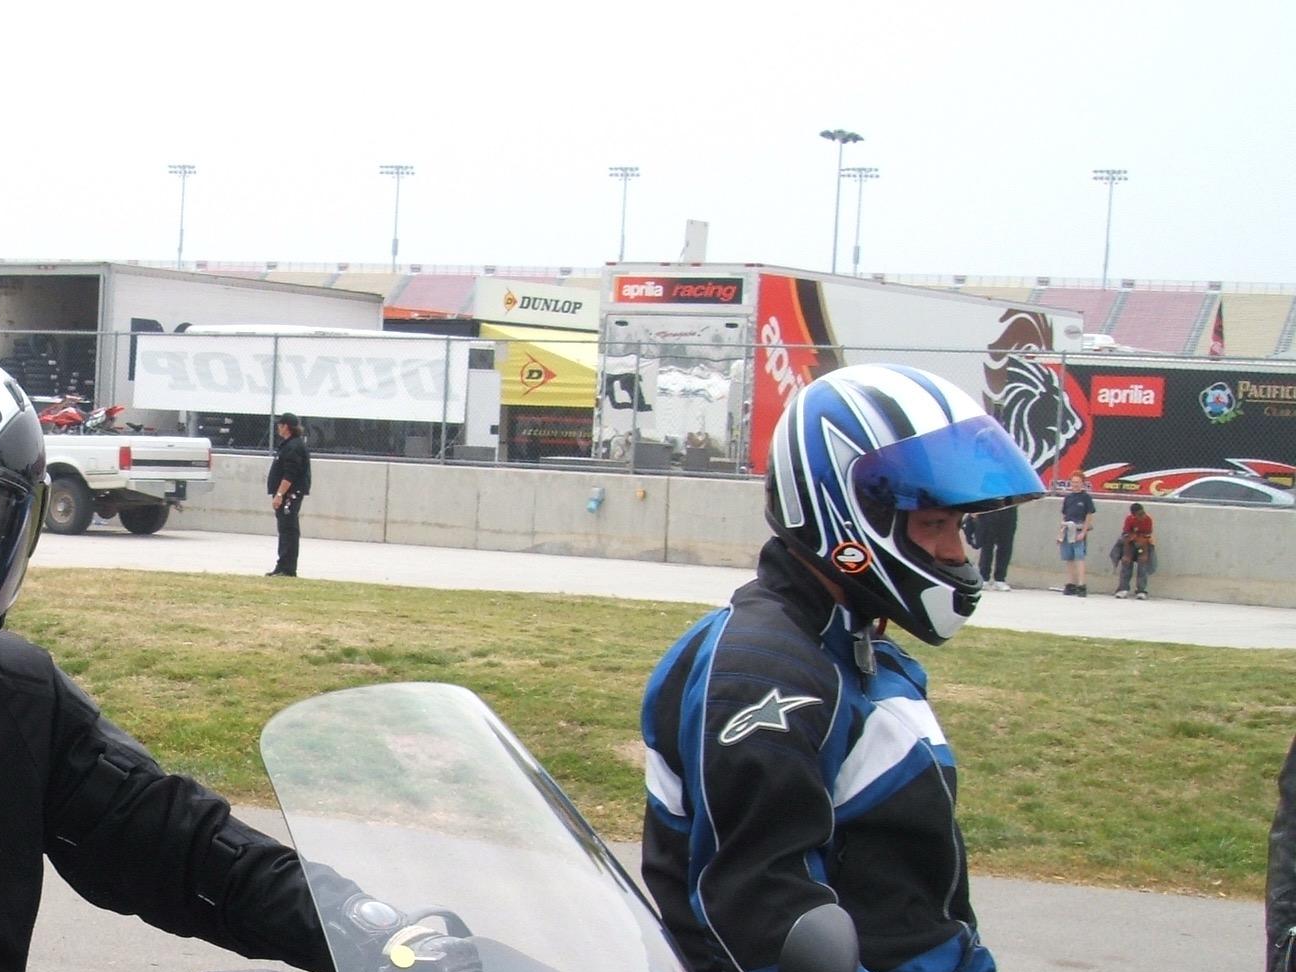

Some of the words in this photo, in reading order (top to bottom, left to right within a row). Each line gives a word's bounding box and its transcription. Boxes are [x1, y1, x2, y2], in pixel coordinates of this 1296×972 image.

[622, 280, 663, 298] aprilia
[672, 282, 737, 301] racing
[519, 295, 583, 315] DUNLOP
[1097, 385, 1155, 407] aprilia
